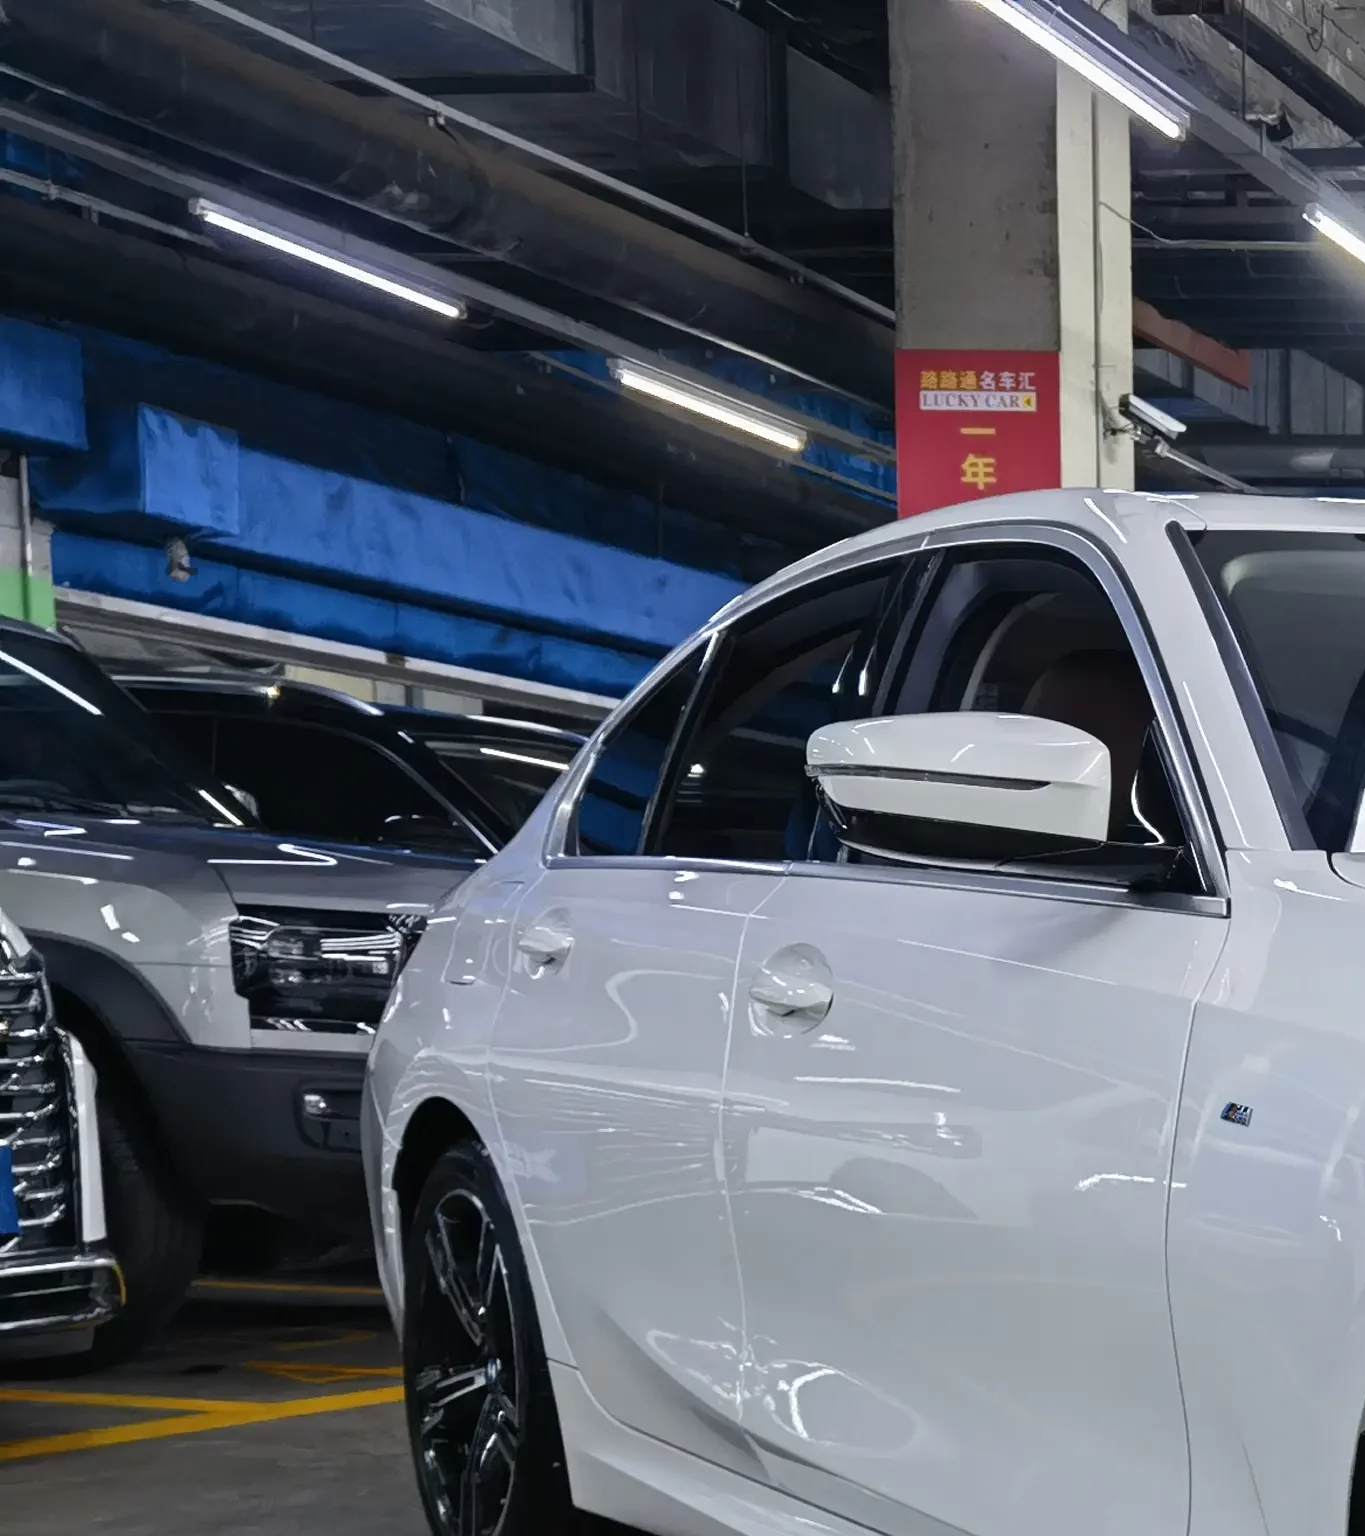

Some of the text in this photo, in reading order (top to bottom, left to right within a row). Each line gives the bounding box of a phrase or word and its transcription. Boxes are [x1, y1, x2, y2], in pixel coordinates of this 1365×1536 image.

[922, 393, 1020, 409] LUCKY CAR
[960, 427, 997, 490] 一年
